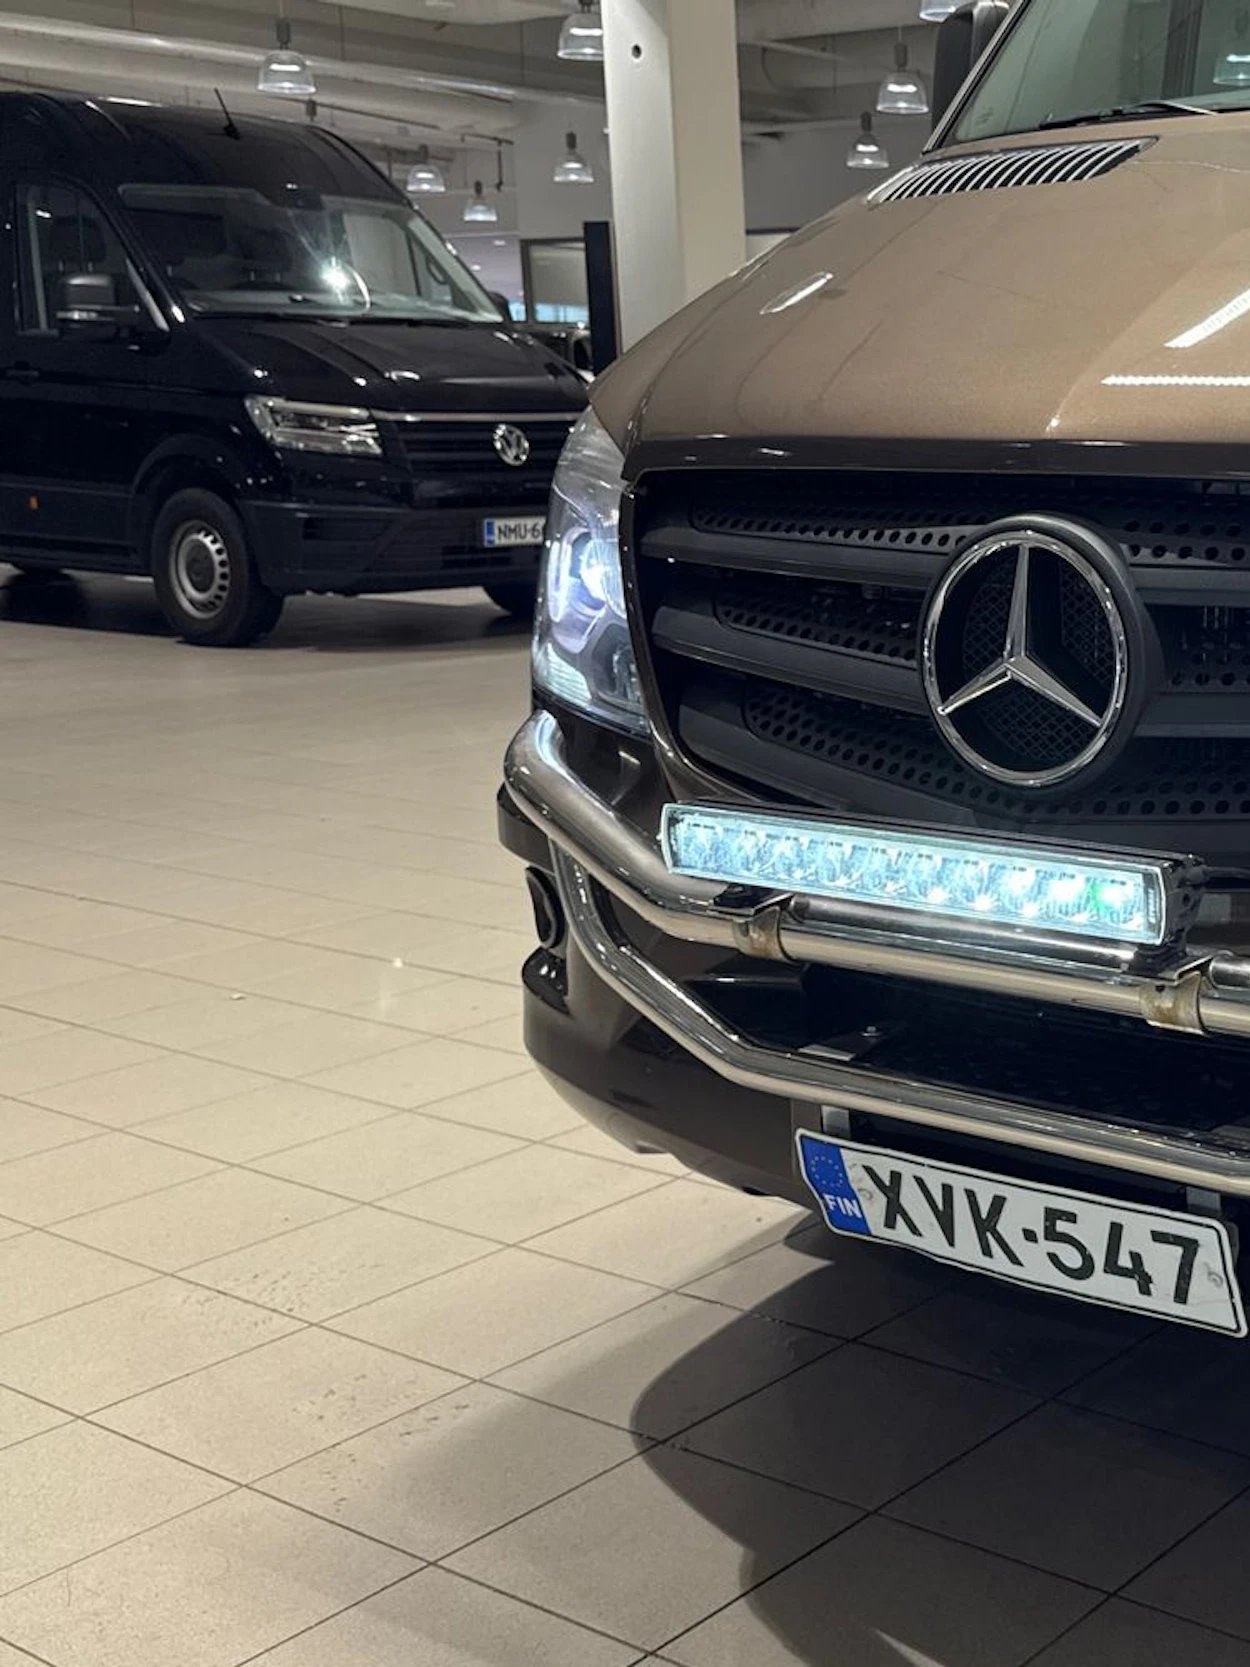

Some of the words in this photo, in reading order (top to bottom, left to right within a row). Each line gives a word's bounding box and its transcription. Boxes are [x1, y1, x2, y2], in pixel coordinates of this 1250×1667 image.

[497, 521, 546, 540] NMU-6
[823, 1193, 863, 1218] FIN
[862, 1164, 1200, 1304] XVK-547
